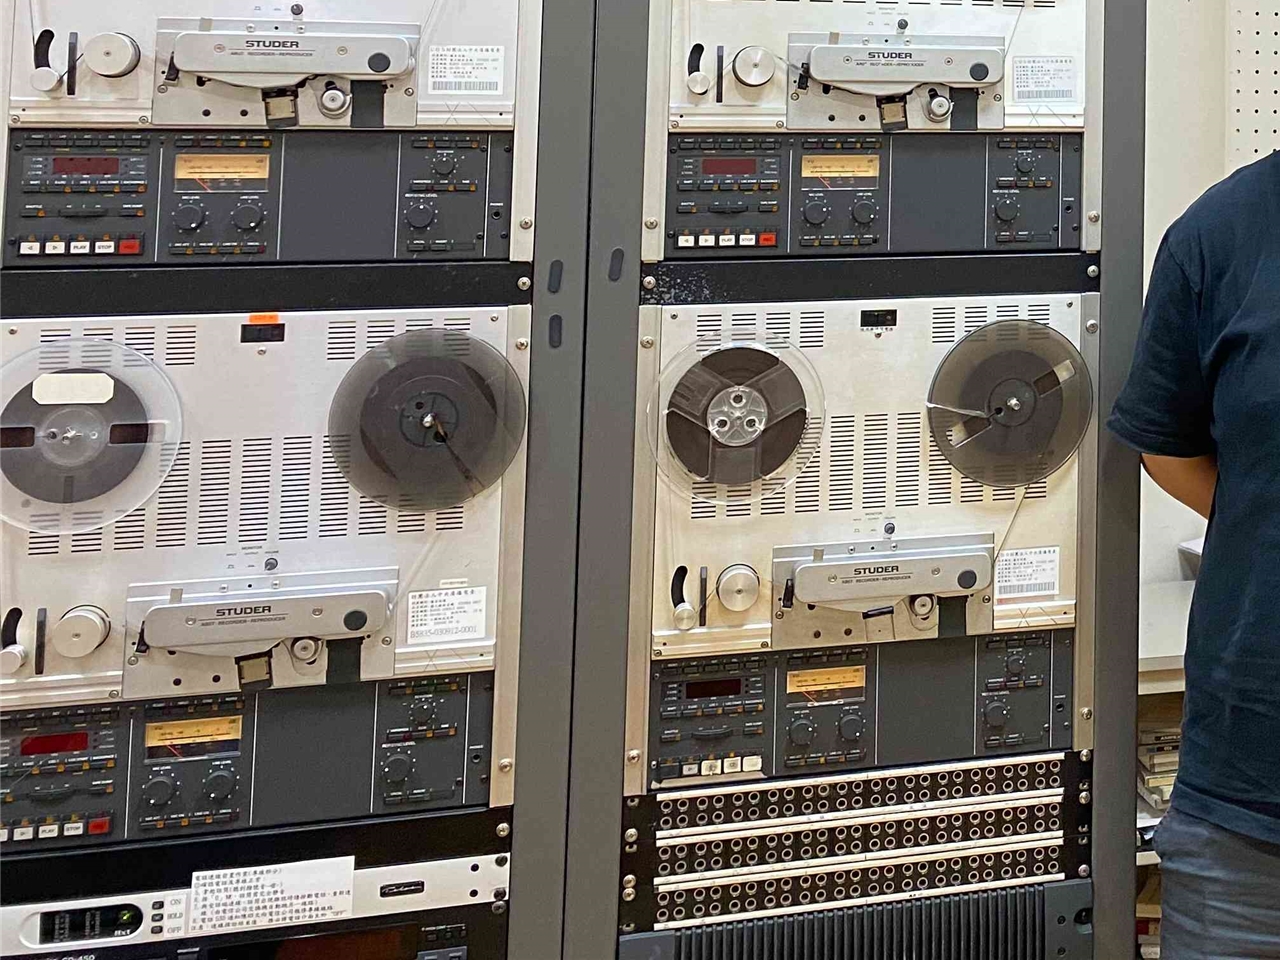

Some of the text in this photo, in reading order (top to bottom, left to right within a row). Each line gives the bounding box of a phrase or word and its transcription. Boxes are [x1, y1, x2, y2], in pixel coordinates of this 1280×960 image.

[245, 40, 299, 48] STUDER
[868, 51, 912, 59] STUDER
[853, 565, 899, 576] STUDER
[216, 605, 271, 617] STUDER
[170, 898, 182, 906] ON
[167, 911, 184, 920] HOLD
[167, 926, 182, 934] OFF
